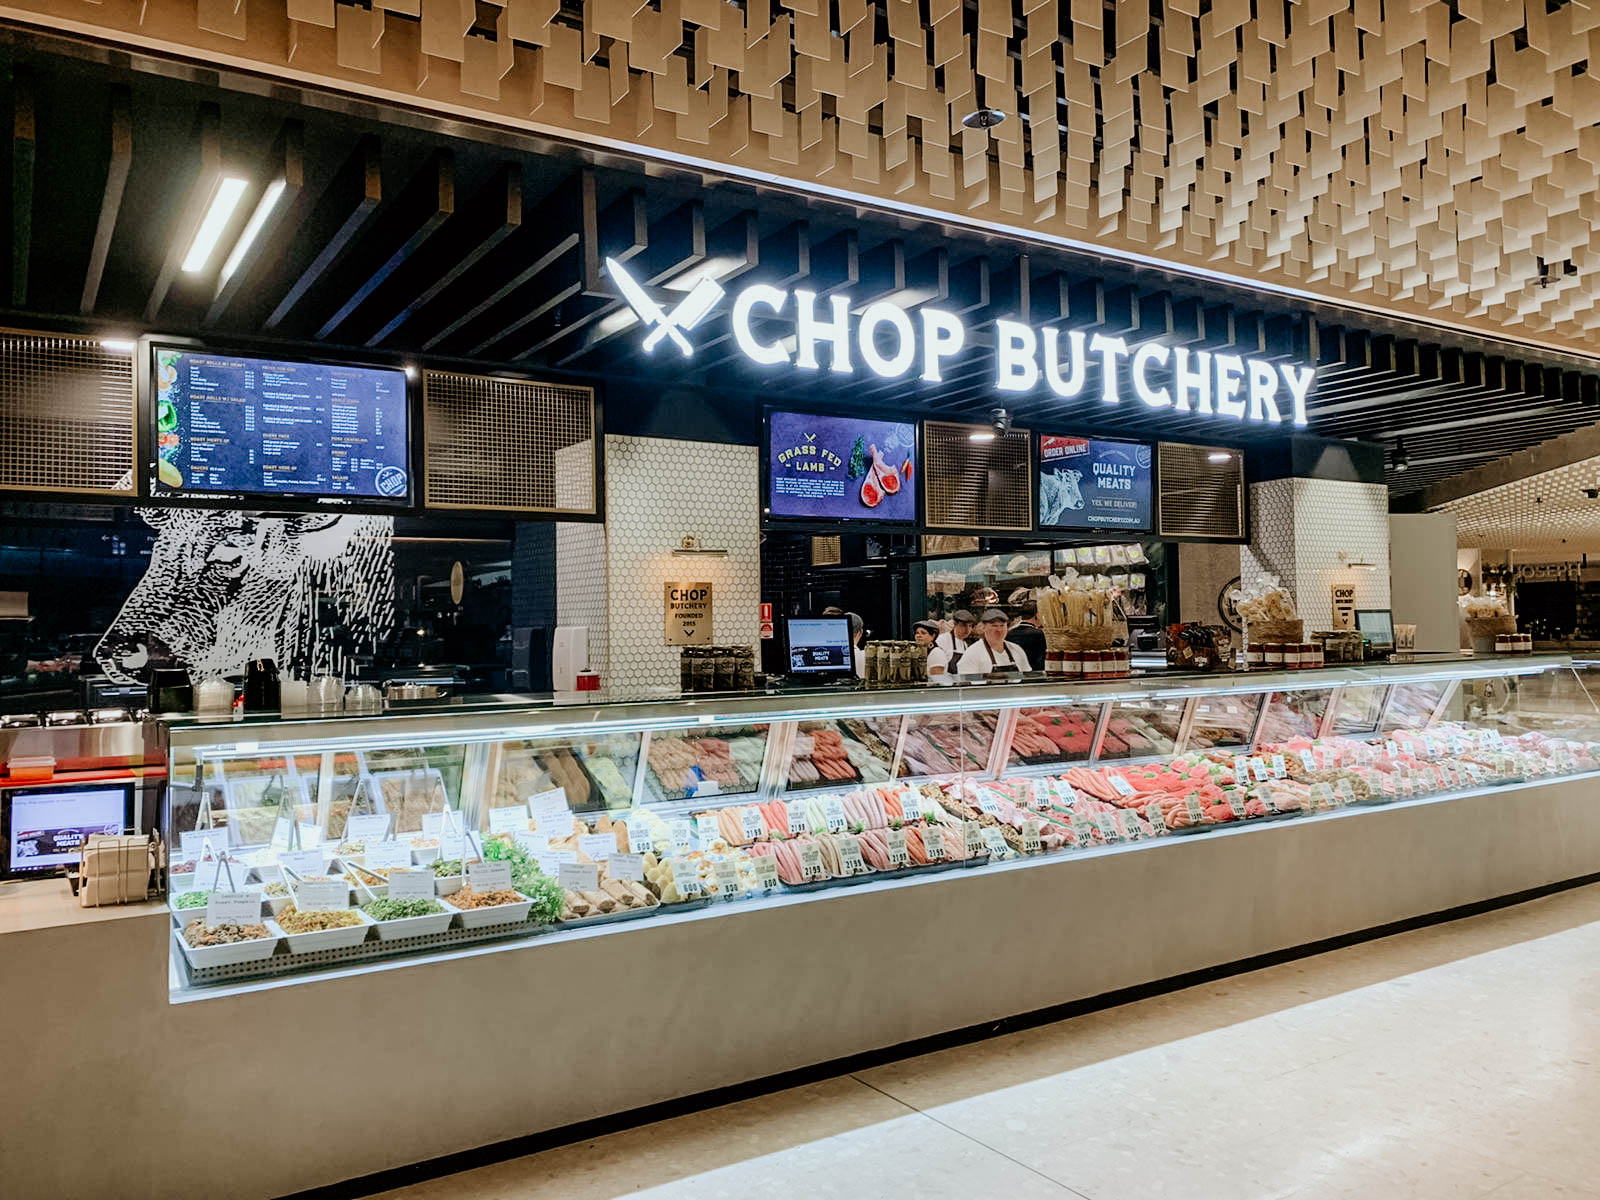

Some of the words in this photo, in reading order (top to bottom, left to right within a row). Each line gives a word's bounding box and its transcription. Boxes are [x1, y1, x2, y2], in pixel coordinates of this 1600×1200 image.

[732, 284, 966, 383] CHOP
[994, 318, 1316, 426] BUTCHERY
[1043, 446, 1064, 458] ORDER
[1064, 443, 1087, 454] ONLINE
[778, 445, 817, 464] GRASS
[821, 448, 842, 468] FED
[796, 461, 825, 473] LAMB
[1092, 462, 1136, 477] QUALITY
[380, 472, 403, 493] CHOP
[1097, 477, 1132, 490] MEATS
[670, 589, 708, 601] CHOP
[1335, 588, 1354, 598] CHOP
[670, 602, 707, 610] BUTCHERY
[905, 810, 920, 820] 2199
[791, 823, 806, 833] 2199
[829, 818, 844, 829] 2199
[53, 833, 85, 843] QUALITY
[746, 827, 762, 839] 2199
[56, 839, 81, 847] MEATS
[891, 852, 908, 863] 2199
[928, 848, 945, 858] 2199
[845, 858, 863, 869] 2199
[804, 864, 822, 876] 2199
